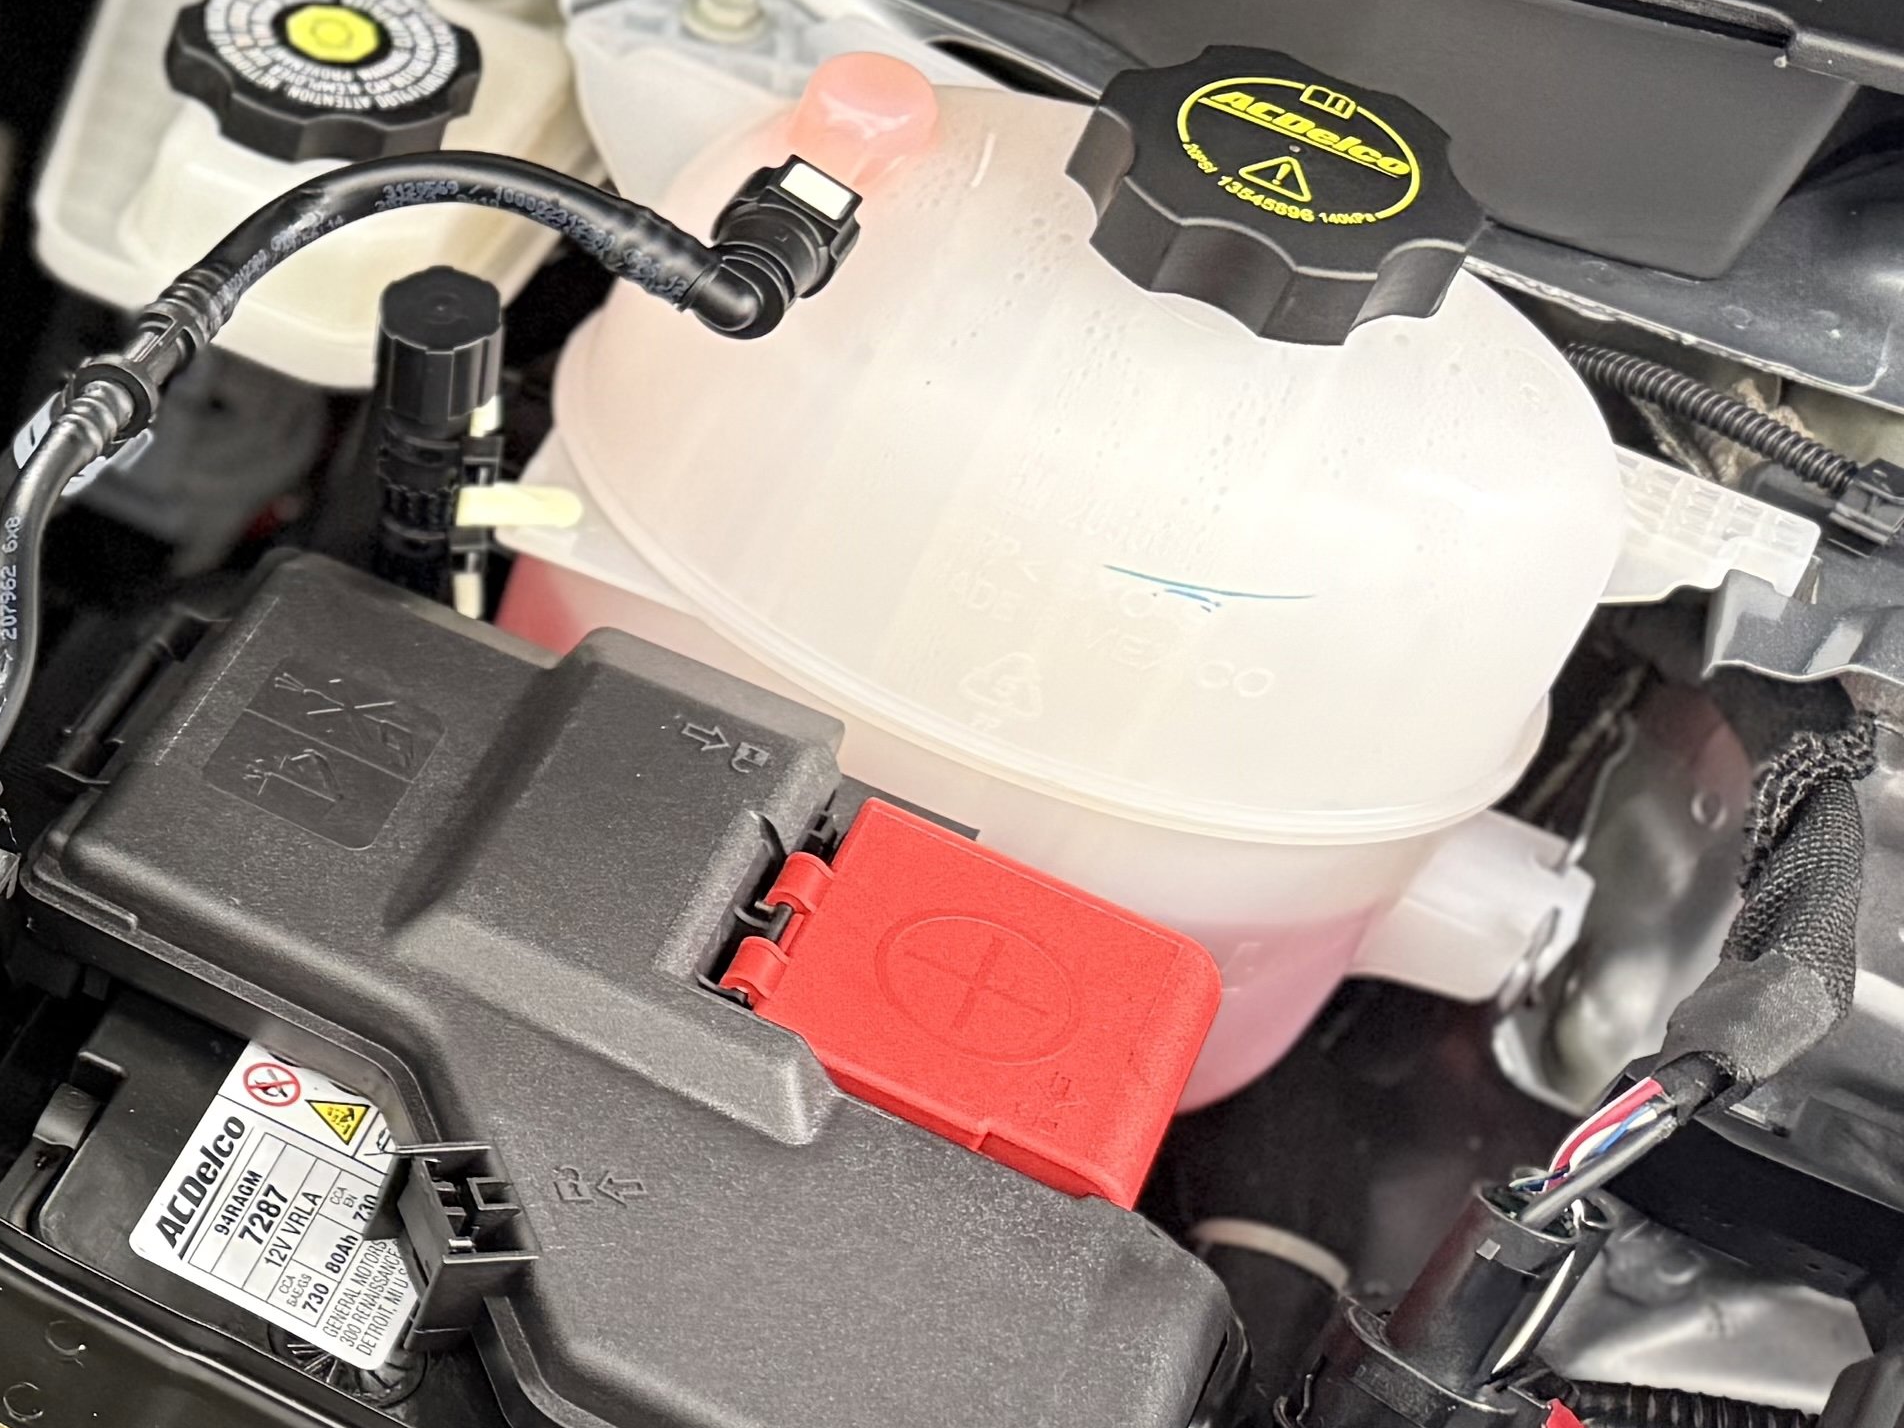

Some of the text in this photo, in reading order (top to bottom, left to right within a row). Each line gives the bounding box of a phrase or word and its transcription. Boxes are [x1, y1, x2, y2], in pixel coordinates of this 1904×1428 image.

[1209, 90, 1411, 176] ACDelco
[156, 1116, 245, 1248] ACDelco
[214, 1170, 263, 1236] 94RAGM
[238, 1184, 288, 1245] 7287
[264, 1192, 323, 1268] 12V VRLA
[325, 1235, 359, 1274] 80Ah
[301, 1283, 330, 1313] 730
[322, 1234, 388, 1338] GENERAL MOTORS
[339, 1247, 403, 1348] 300 RENAISSANCE
